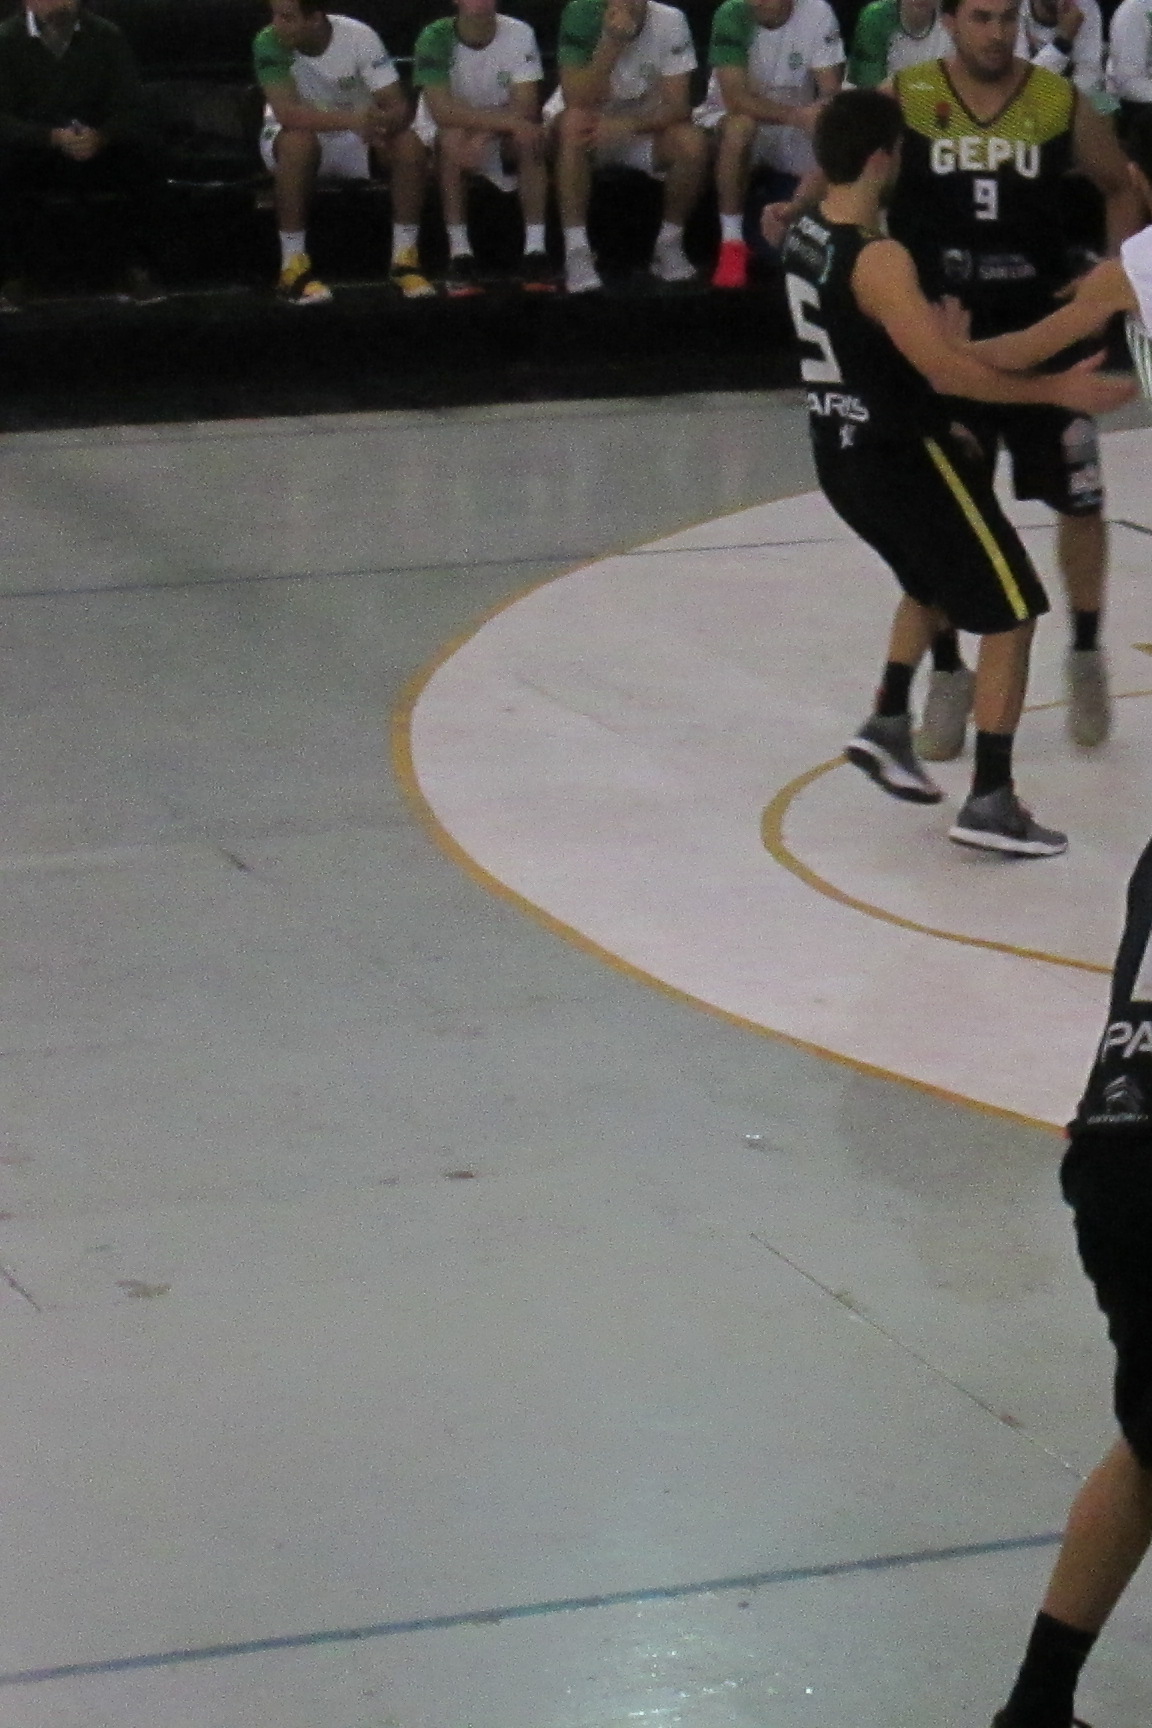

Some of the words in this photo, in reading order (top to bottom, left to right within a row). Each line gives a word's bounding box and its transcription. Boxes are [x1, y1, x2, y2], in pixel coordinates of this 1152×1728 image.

[931, 136, 1041, 178] GEPU
[972, 178, 999, 221] 9
[785, 272, 844, 384] 5
[807, 392, 871, 422] ARIS
